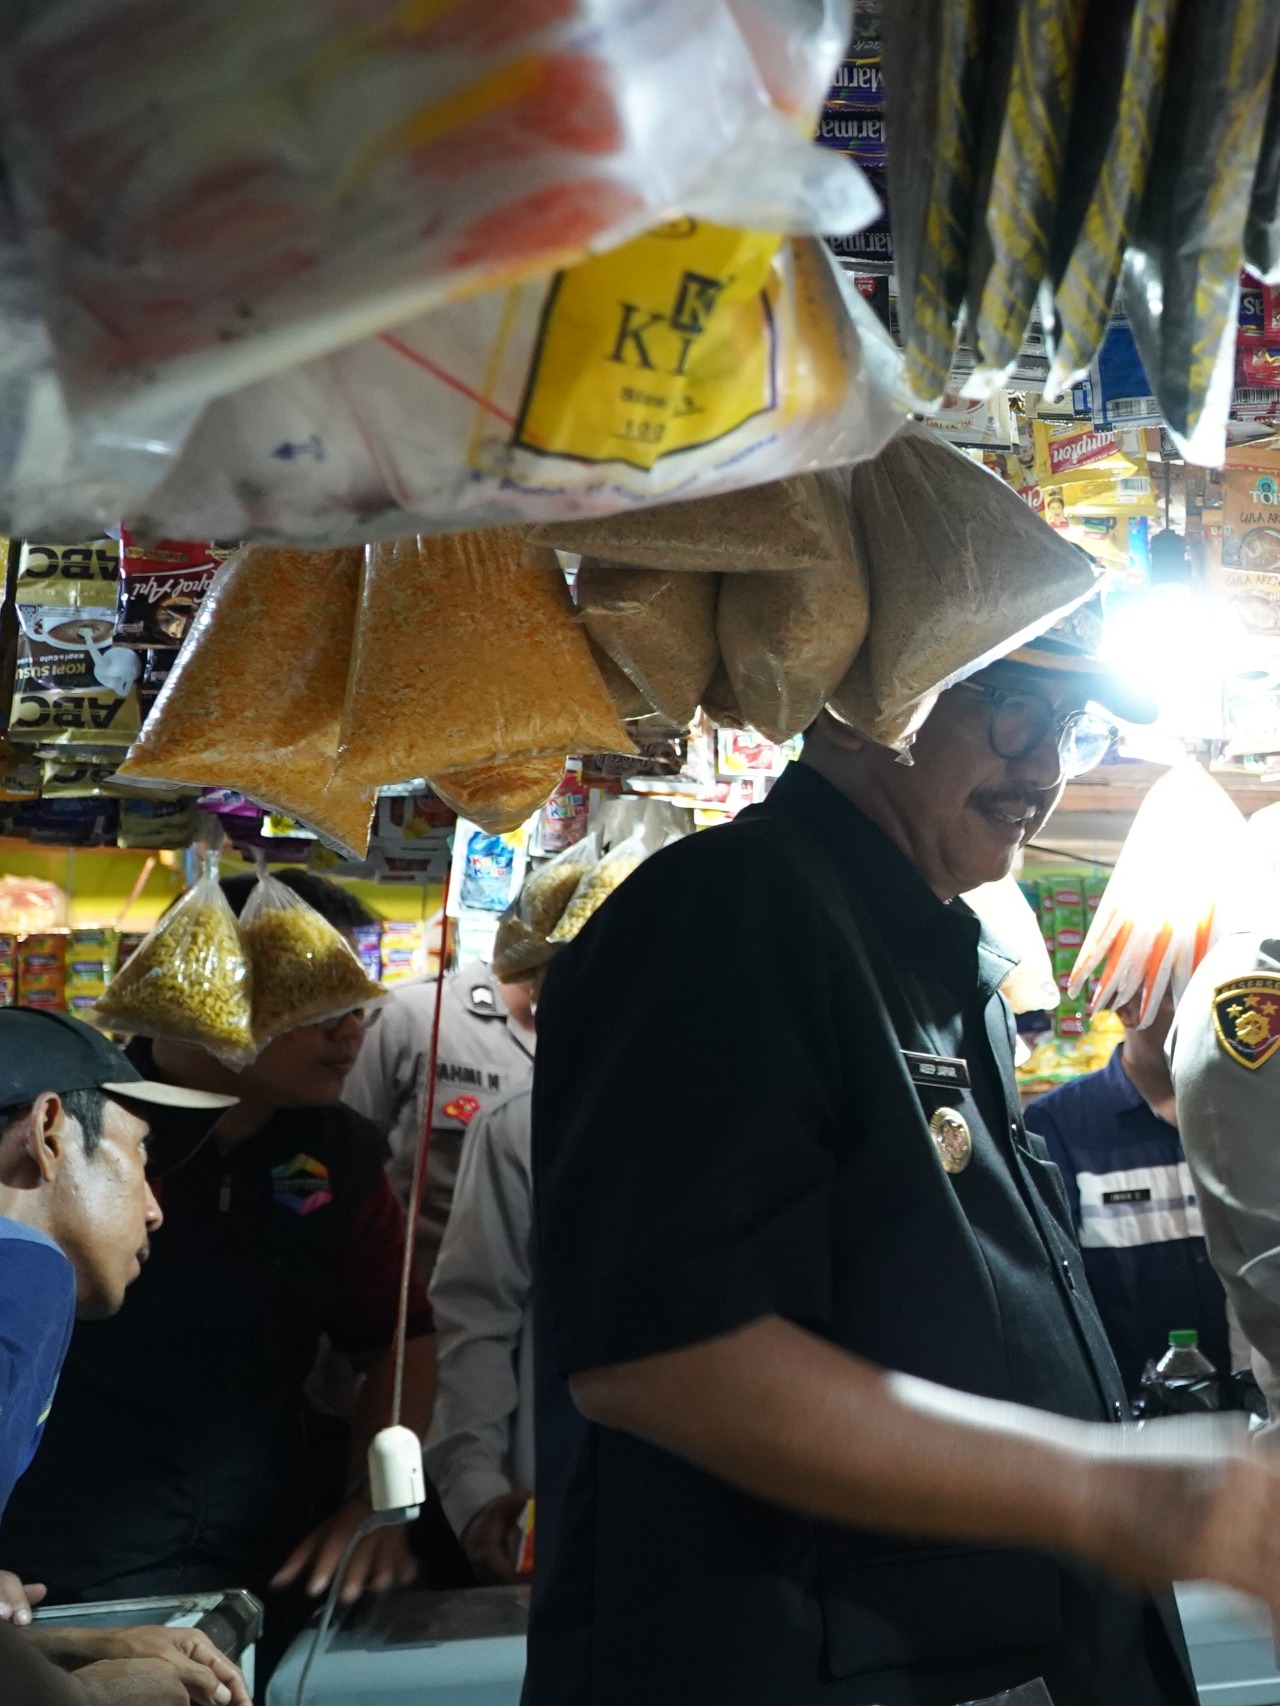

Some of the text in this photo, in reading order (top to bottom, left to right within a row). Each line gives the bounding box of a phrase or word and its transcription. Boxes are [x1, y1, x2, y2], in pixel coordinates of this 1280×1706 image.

[838, 66, 882, 90] Marim
[812, 116, 886, 141] arimas
[830, 230, 893, 255] arima
[1239, 511, 1266, 524] GULA
[25, 546, 120, 580] ABC
[52, 663, 87, 677] KOPI
[19, 695, 127, 730] ABC
